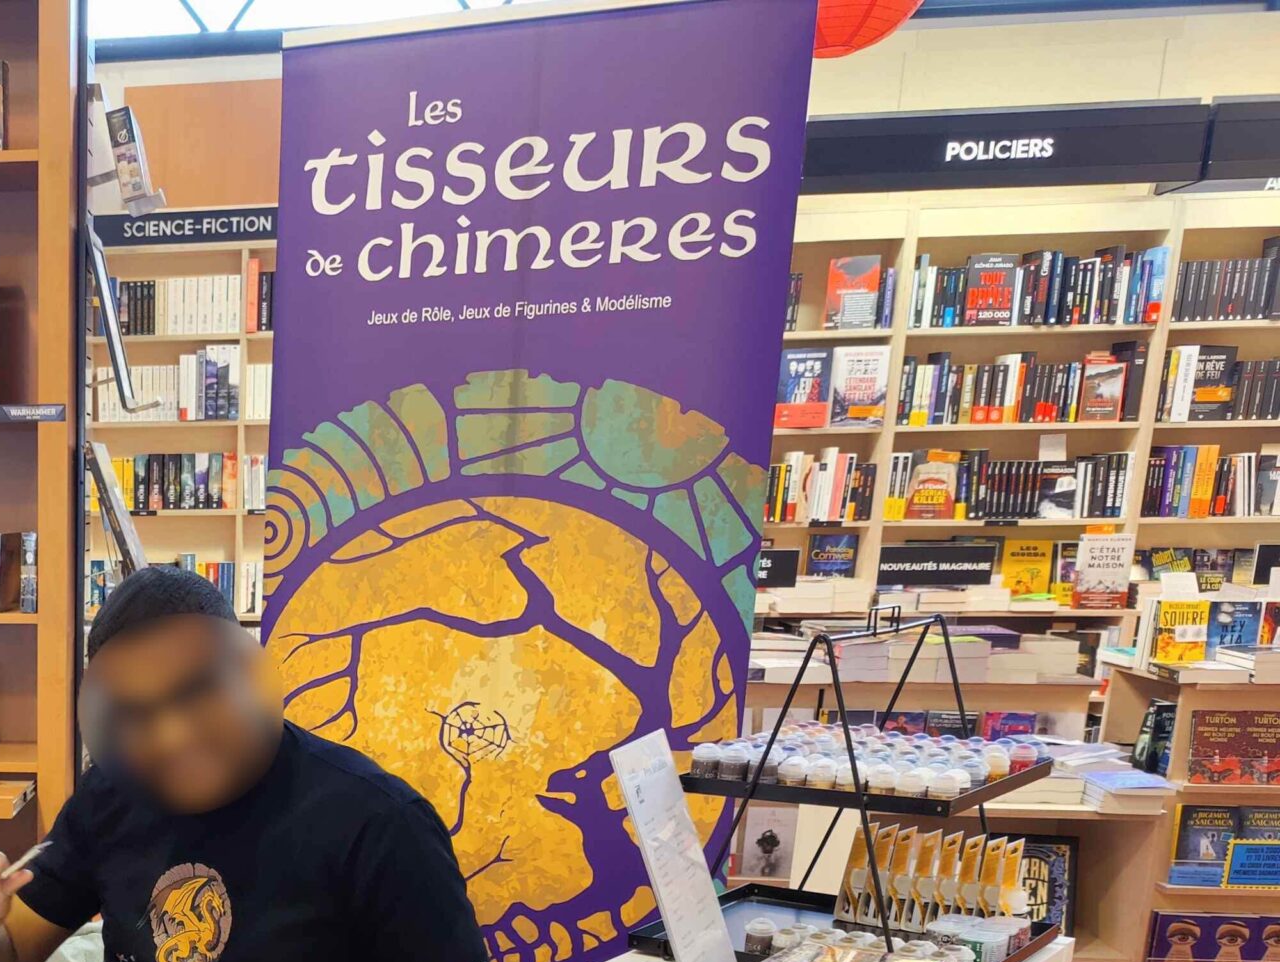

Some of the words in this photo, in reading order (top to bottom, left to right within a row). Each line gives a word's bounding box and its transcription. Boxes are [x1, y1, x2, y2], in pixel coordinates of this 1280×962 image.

[407, 91, 463, 127] Les
[945, 137, 1054, 162] POLICIERS
[123, 215, 272, 238] SCIENCE-FICTION
[305, 250, 343, 277] de
[367, 310, 399, 326] Jeux
[402, 308, 418, 323] de
[421, 305, 455, 323] Rôle,
[458, 304, 491, 320] Jeux
[494, 302, 511, 318] de
[515, 298, 578, 321] Figurines
[581, 298, 592, 313] &
[596, 293, 672, 312] Modélisme
[10, 408, 56, 417] WARHAMMER
[914, 496, 945, 504] KILLER
[1089, 546, 1126, 554] C'ÉTAIT
[880, 561, 938, 571] NOUVEAUTÉS
[939, 562, 991, 571] IMAGINAIRE
[1205, 716, 1237, 724] TURTON
[1195, 818, 1233, 827] SALOMON
